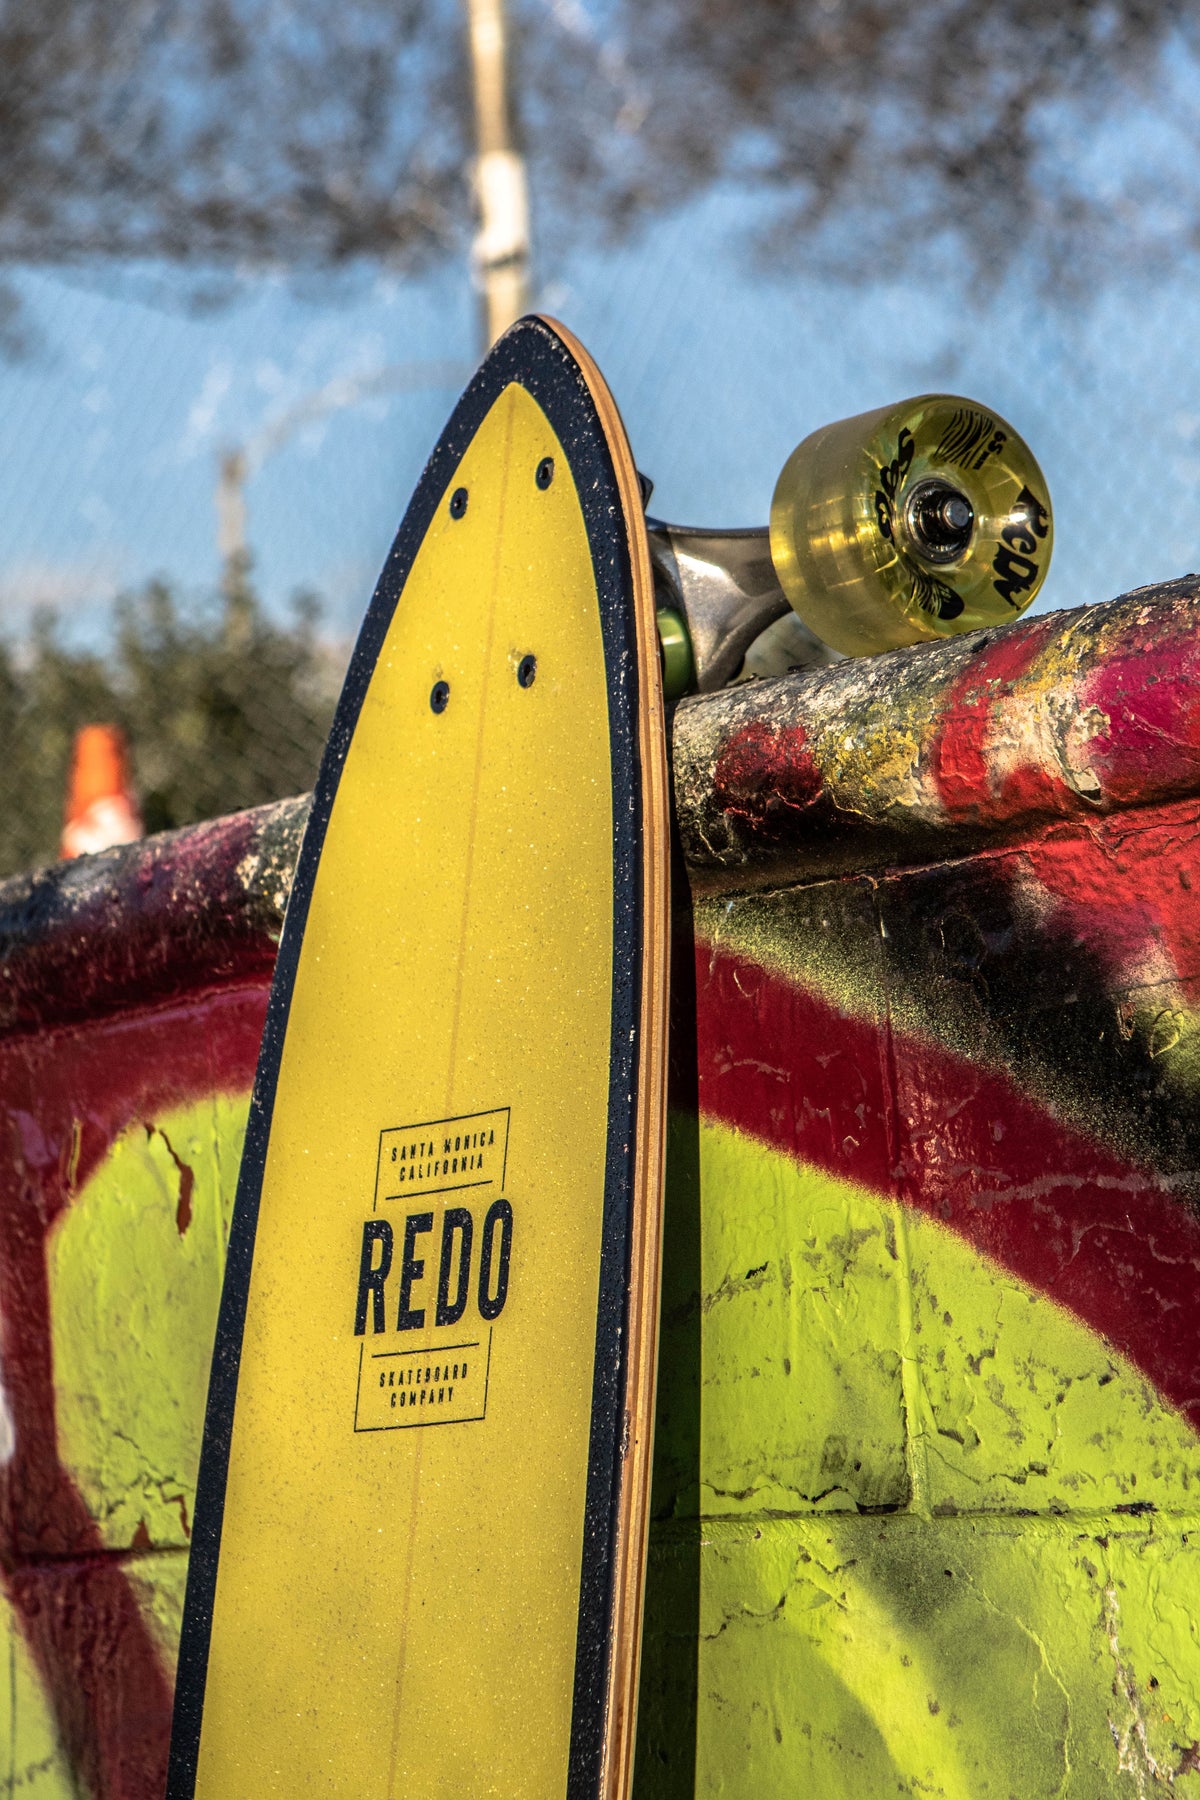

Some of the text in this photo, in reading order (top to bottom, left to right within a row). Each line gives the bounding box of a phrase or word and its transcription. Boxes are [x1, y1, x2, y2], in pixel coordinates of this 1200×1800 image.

[391, 1129, 494, 1162] SANTA MONICA
[399, 1153, 483, 1182] CALIFORNIA
[354, 1198, 513, 1336] REDO
[379, 1363, 468, 1388] SKATEBOARD
[390, 1387, 454, 1408] COMPANY
